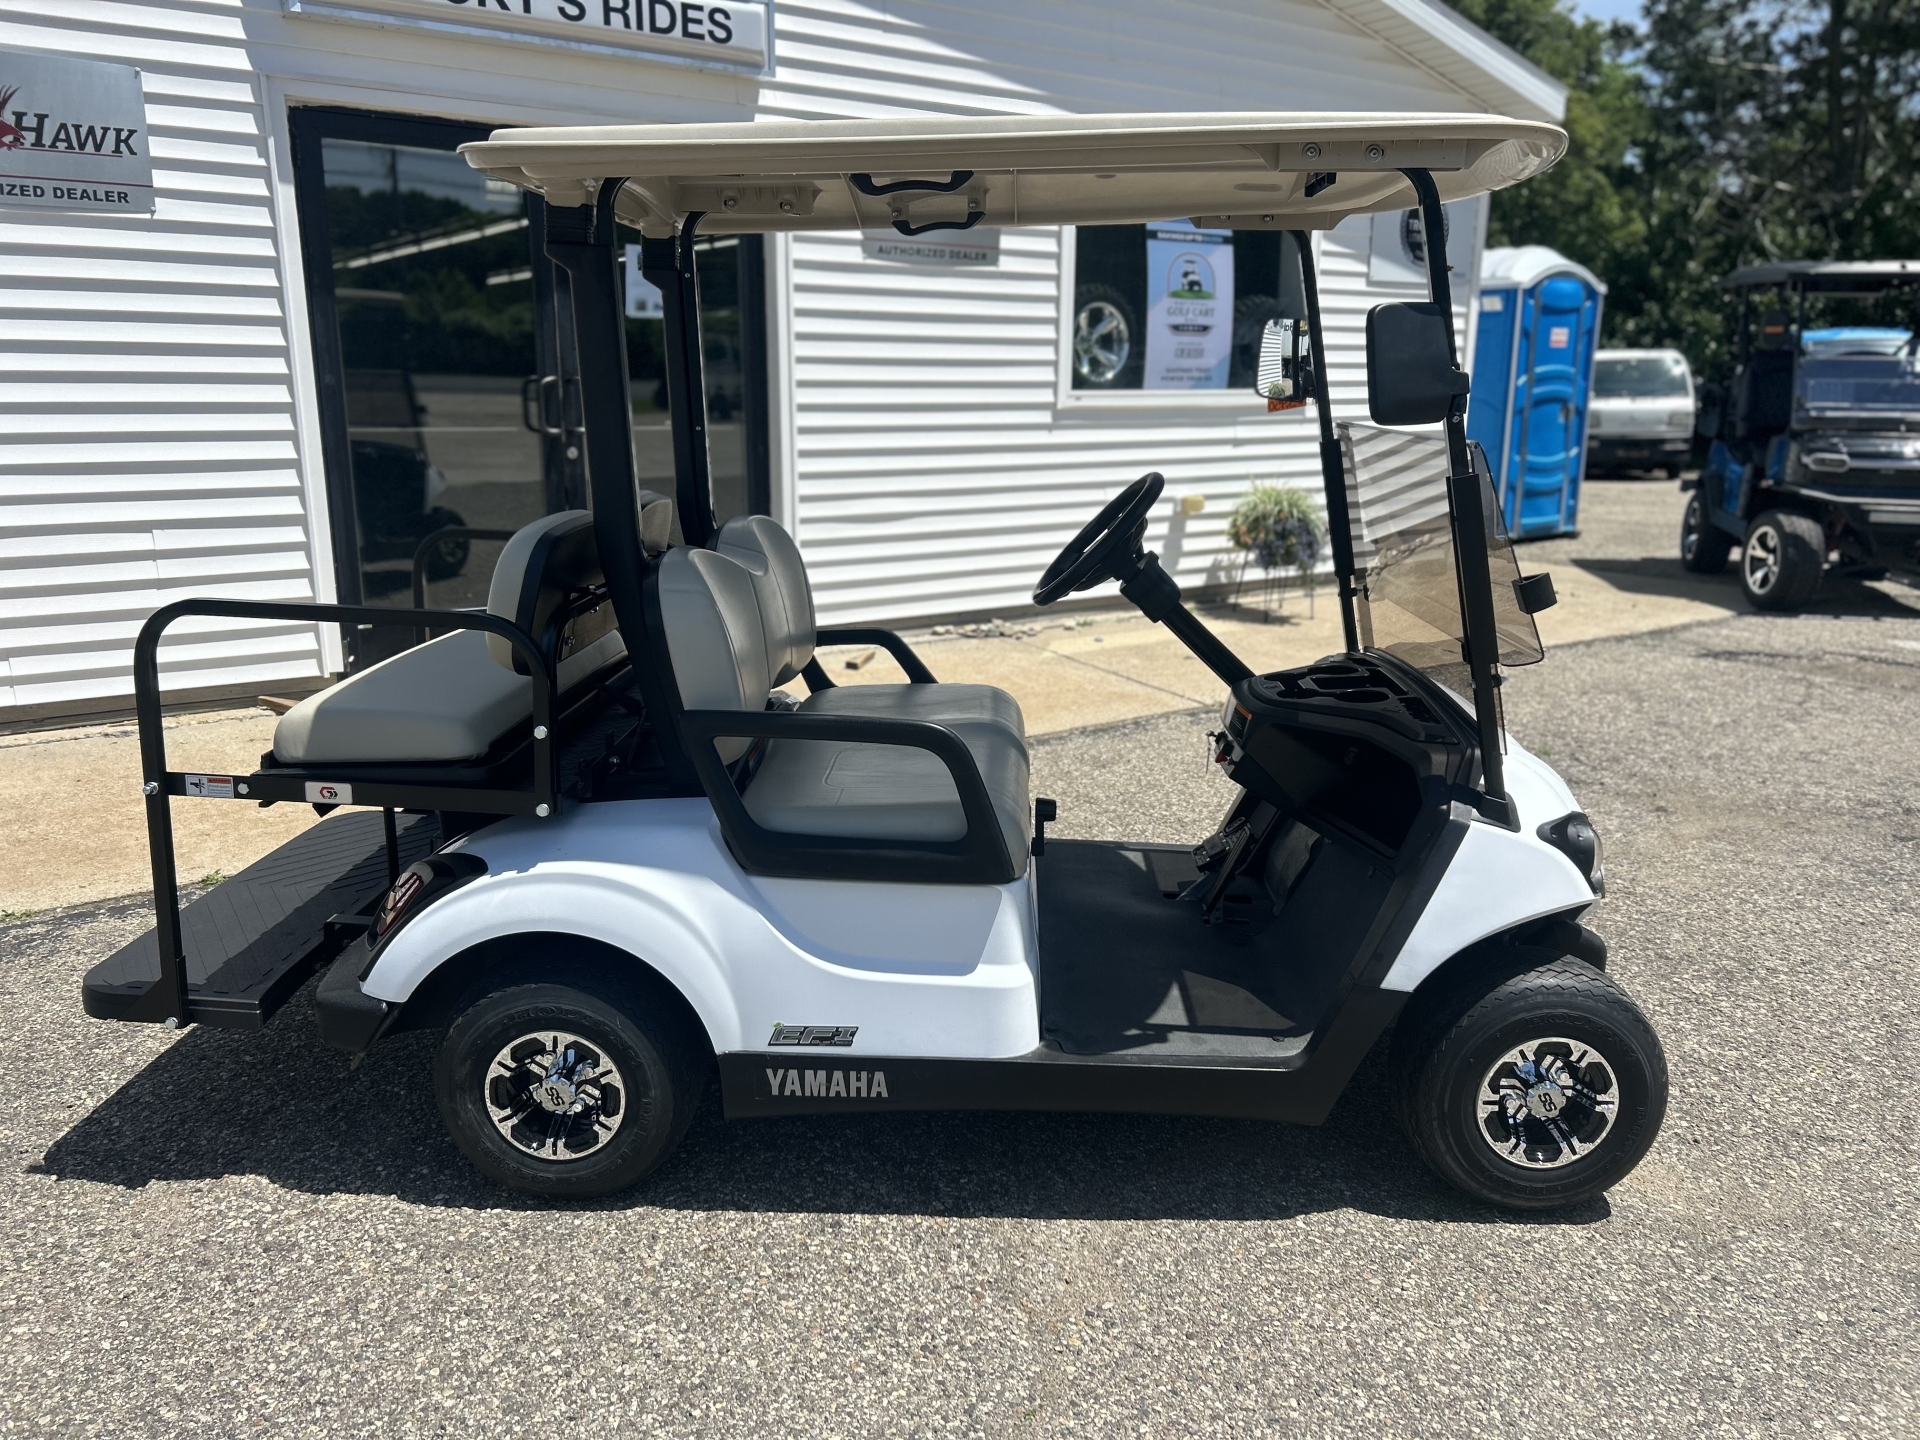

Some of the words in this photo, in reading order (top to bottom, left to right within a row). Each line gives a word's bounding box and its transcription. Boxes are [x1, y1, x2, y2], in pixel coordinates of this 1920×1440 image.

[602, 0, 733, 44] RIDES
[9, 111, 138, 156] HAWK
[52, 186, 130, 204] DEALER
[877, 245, 946, 259] AUTHORIZED
[949, 250, 988, 261] DEALER
[770, 1026, 857, 1044] EFI
[765, 1068, 889, 1098] YAMAHA
